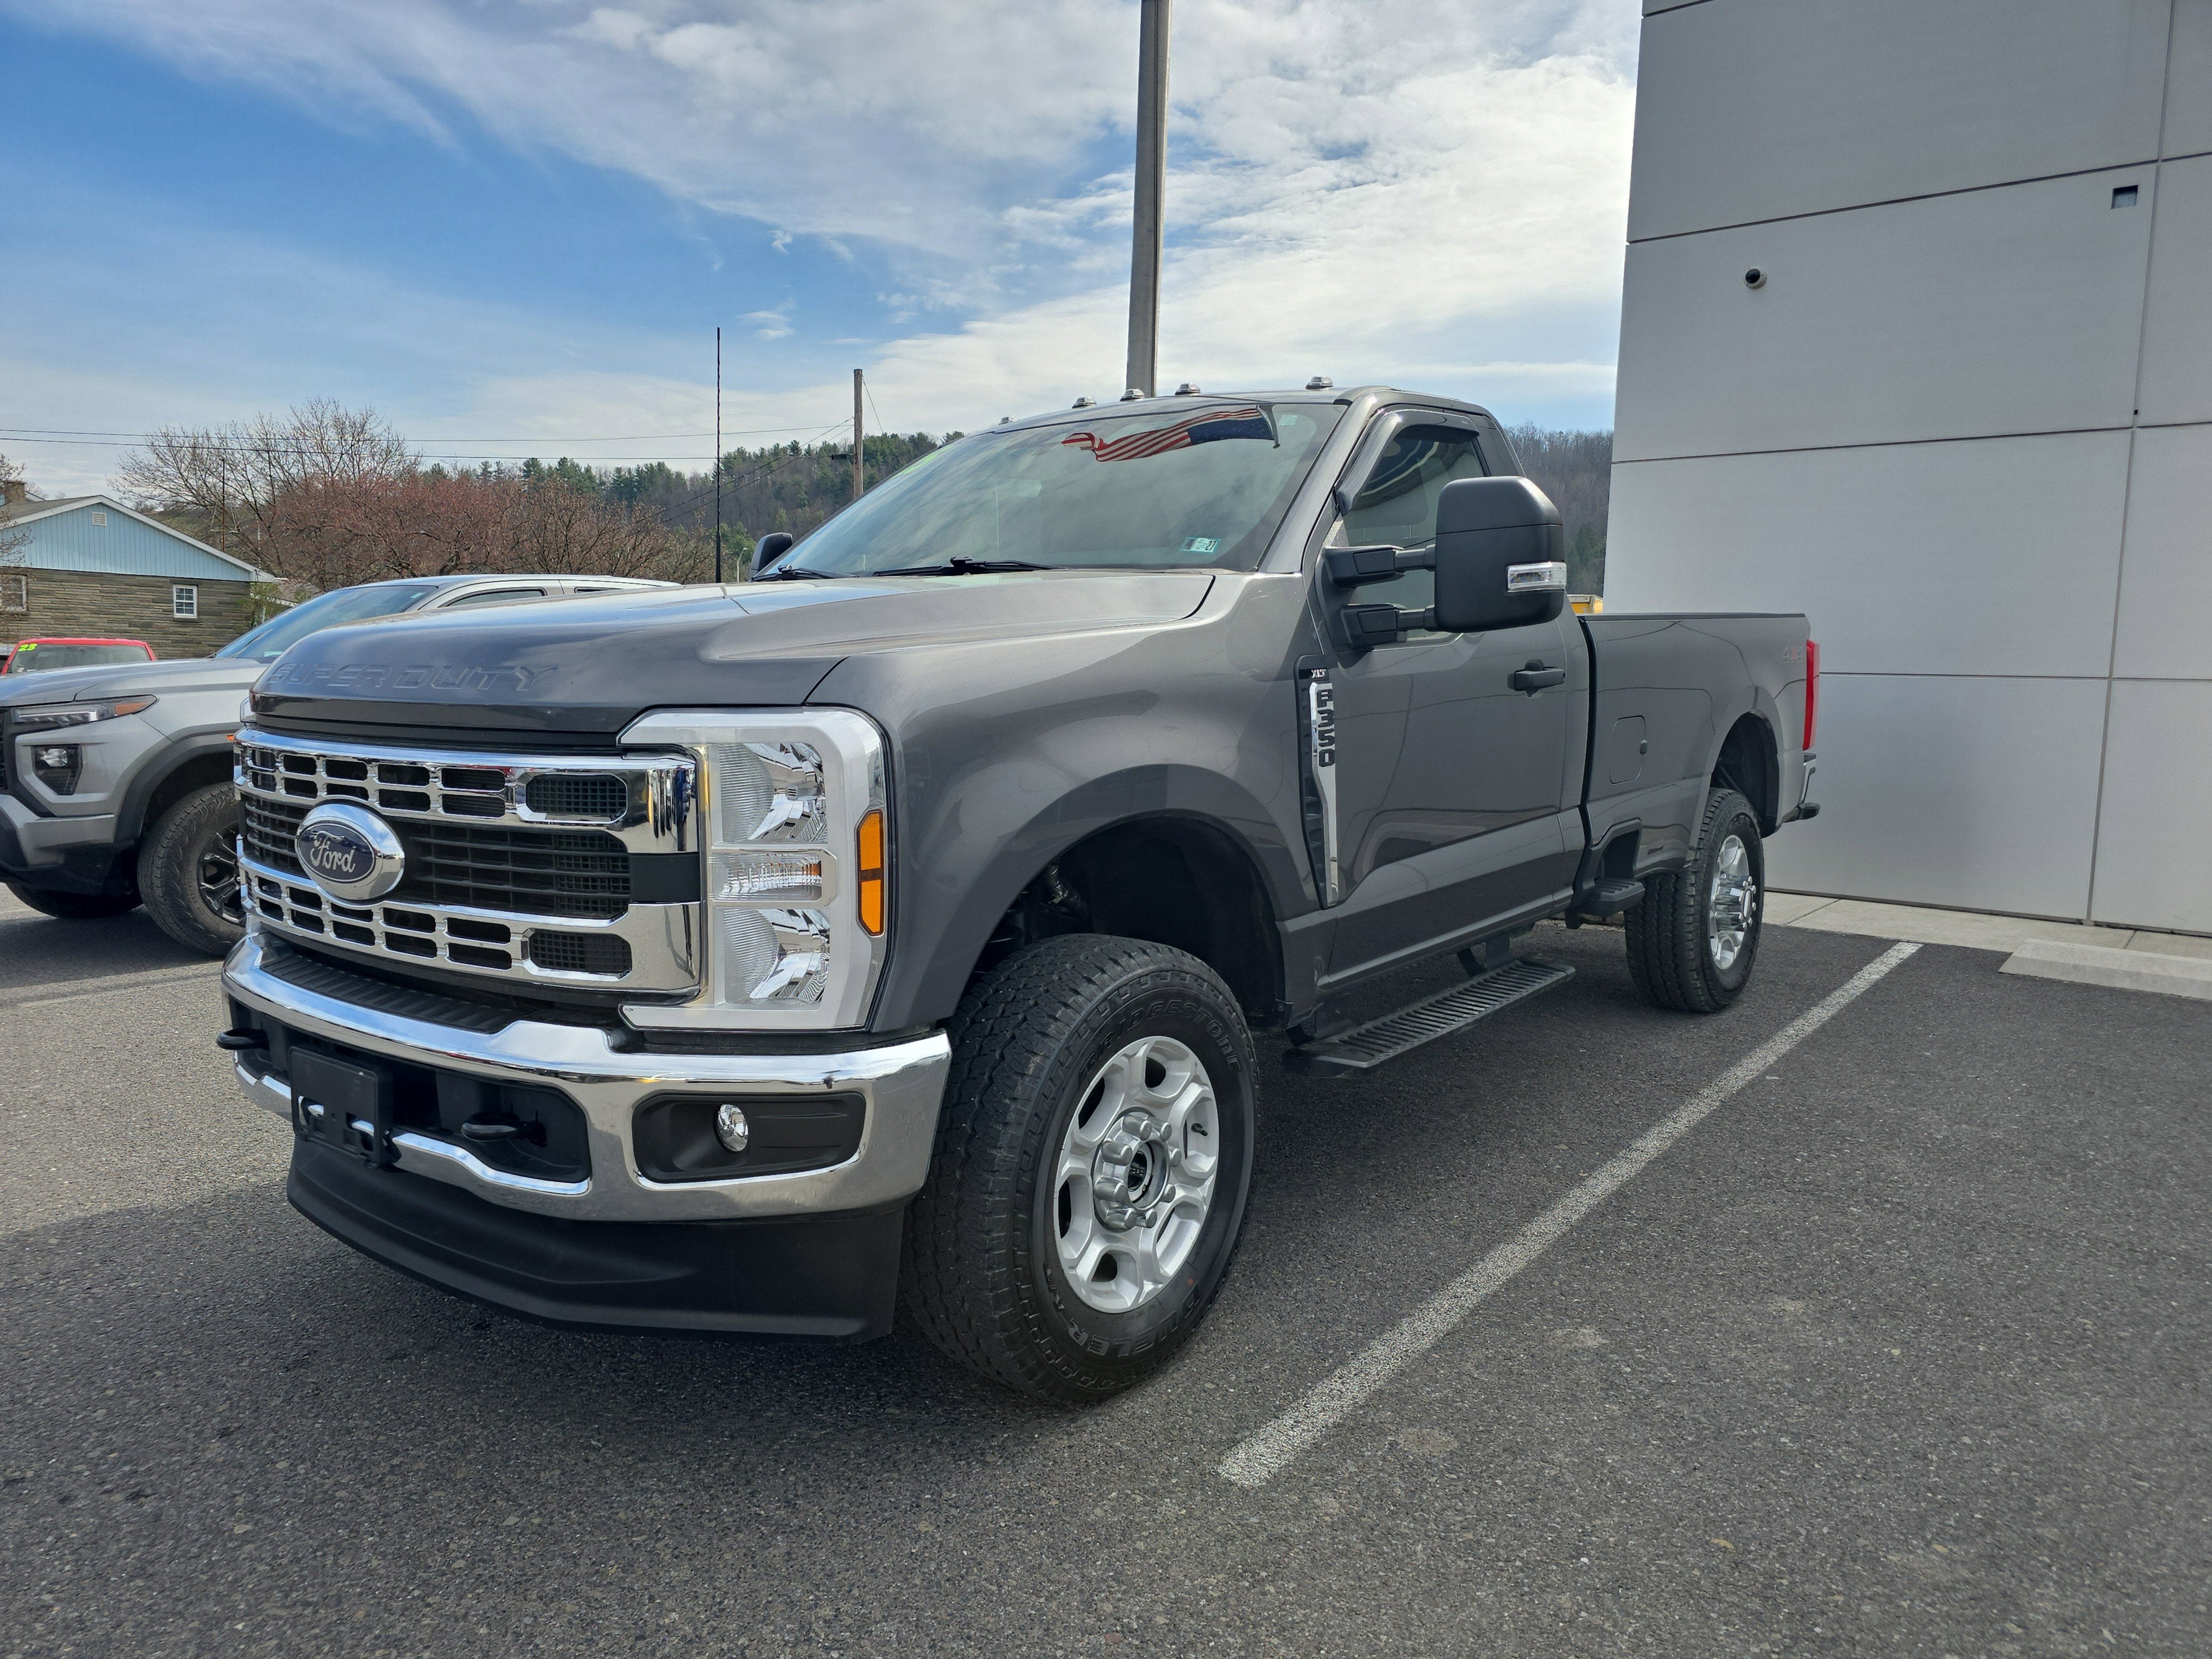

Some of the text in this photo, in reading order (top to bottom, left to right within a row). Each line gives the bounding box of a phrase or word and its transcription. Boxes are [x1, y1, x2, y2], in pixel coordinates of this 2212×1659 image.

[1205, 541, 1217, 551] 27
[267, 662, 558, 692] SUPER DUTY
[1310, 669, 1327, 679] XLT
[309, 831, 357, 873] Ford
[1078, 999, 1243, 1083] BRIDGESTONE
[1067, 1284, 1200, 1358] DUELER
